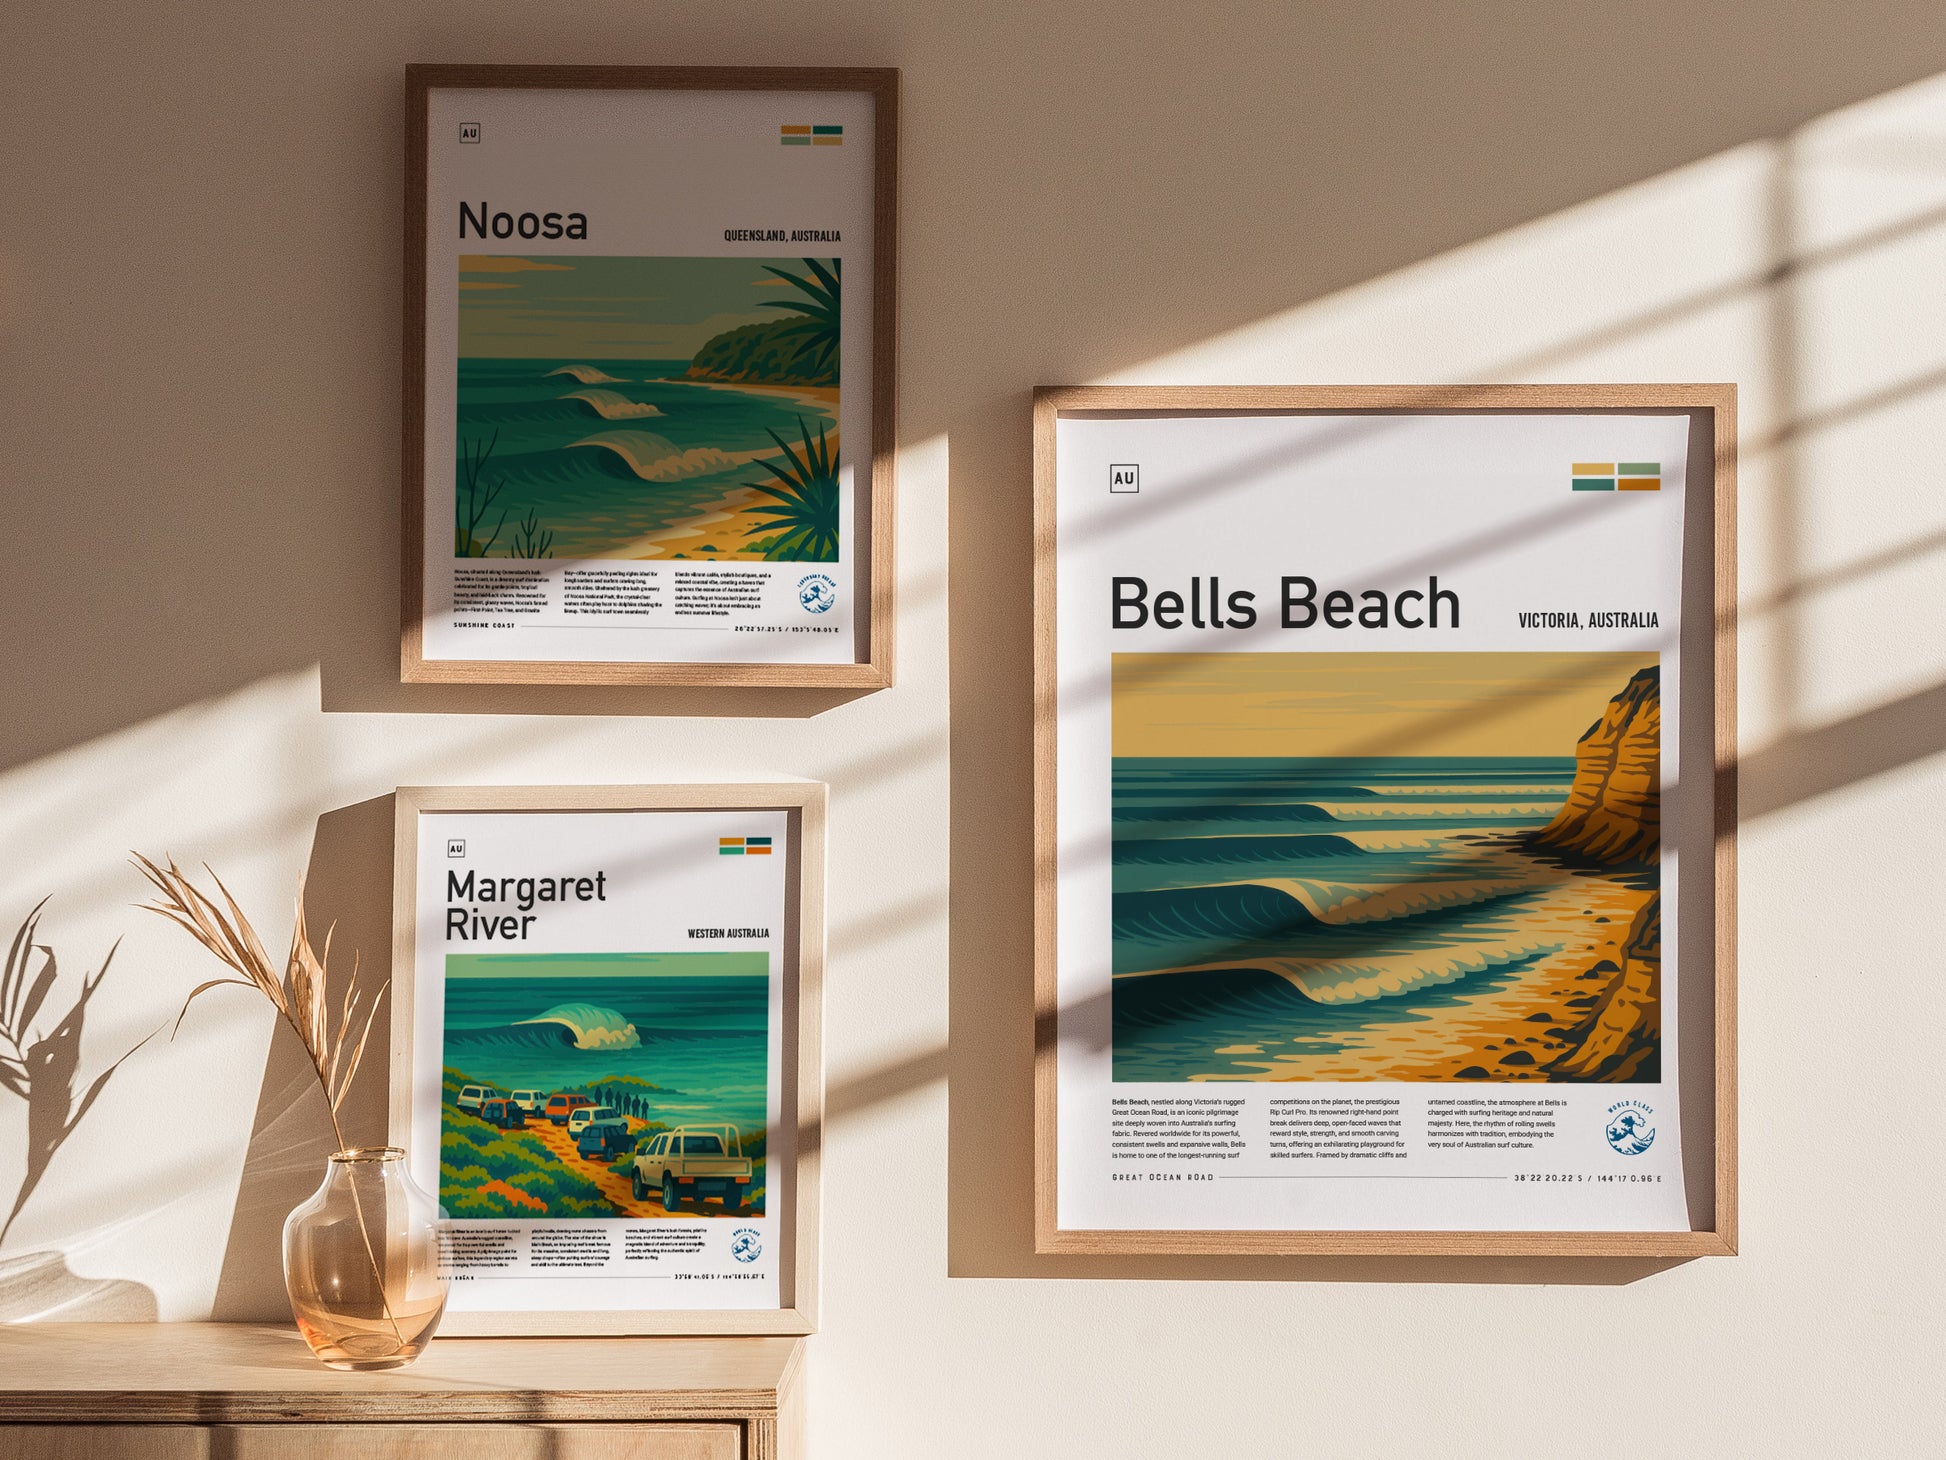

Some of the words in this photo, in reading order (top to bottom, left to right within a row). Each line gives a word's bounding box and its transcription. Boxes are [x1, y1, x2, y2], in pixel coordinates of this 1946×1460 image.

[463, 129, 476, 138] AU
[460, 202, 587, 239] Noosa
[725, 230, 788, 242] QUEENSLAND,
[791, 230, 841, 241] AUSTRALIA
[1115, 472, 1133, 484] AU
[1113, 577, 1257, 629] Bells
[1281, 576, 1459, 629] Beach
[1519, 613, 1583, 630] VICTORIA,
[1589, 612, 1658, 628] AUSTRALIA
[447, 870, 607, 911] Margaret
[446, 908, 537, 940] River
[688, 928, 724, 939] WESTERN
[727, 928, 769, 939] AUSTRALIA
[1428, 1109, 1453, 1117] charged
[1608, 1100, 1630, 1113] WORLD
[1633, 1100, 1653, 1114] CLASS
[1113, 1173, 1142, 1181] GREAT
[1150, 1173, 1180, 1181] OCEAN
[1188, 1173, 1213, 1181] ROAD
